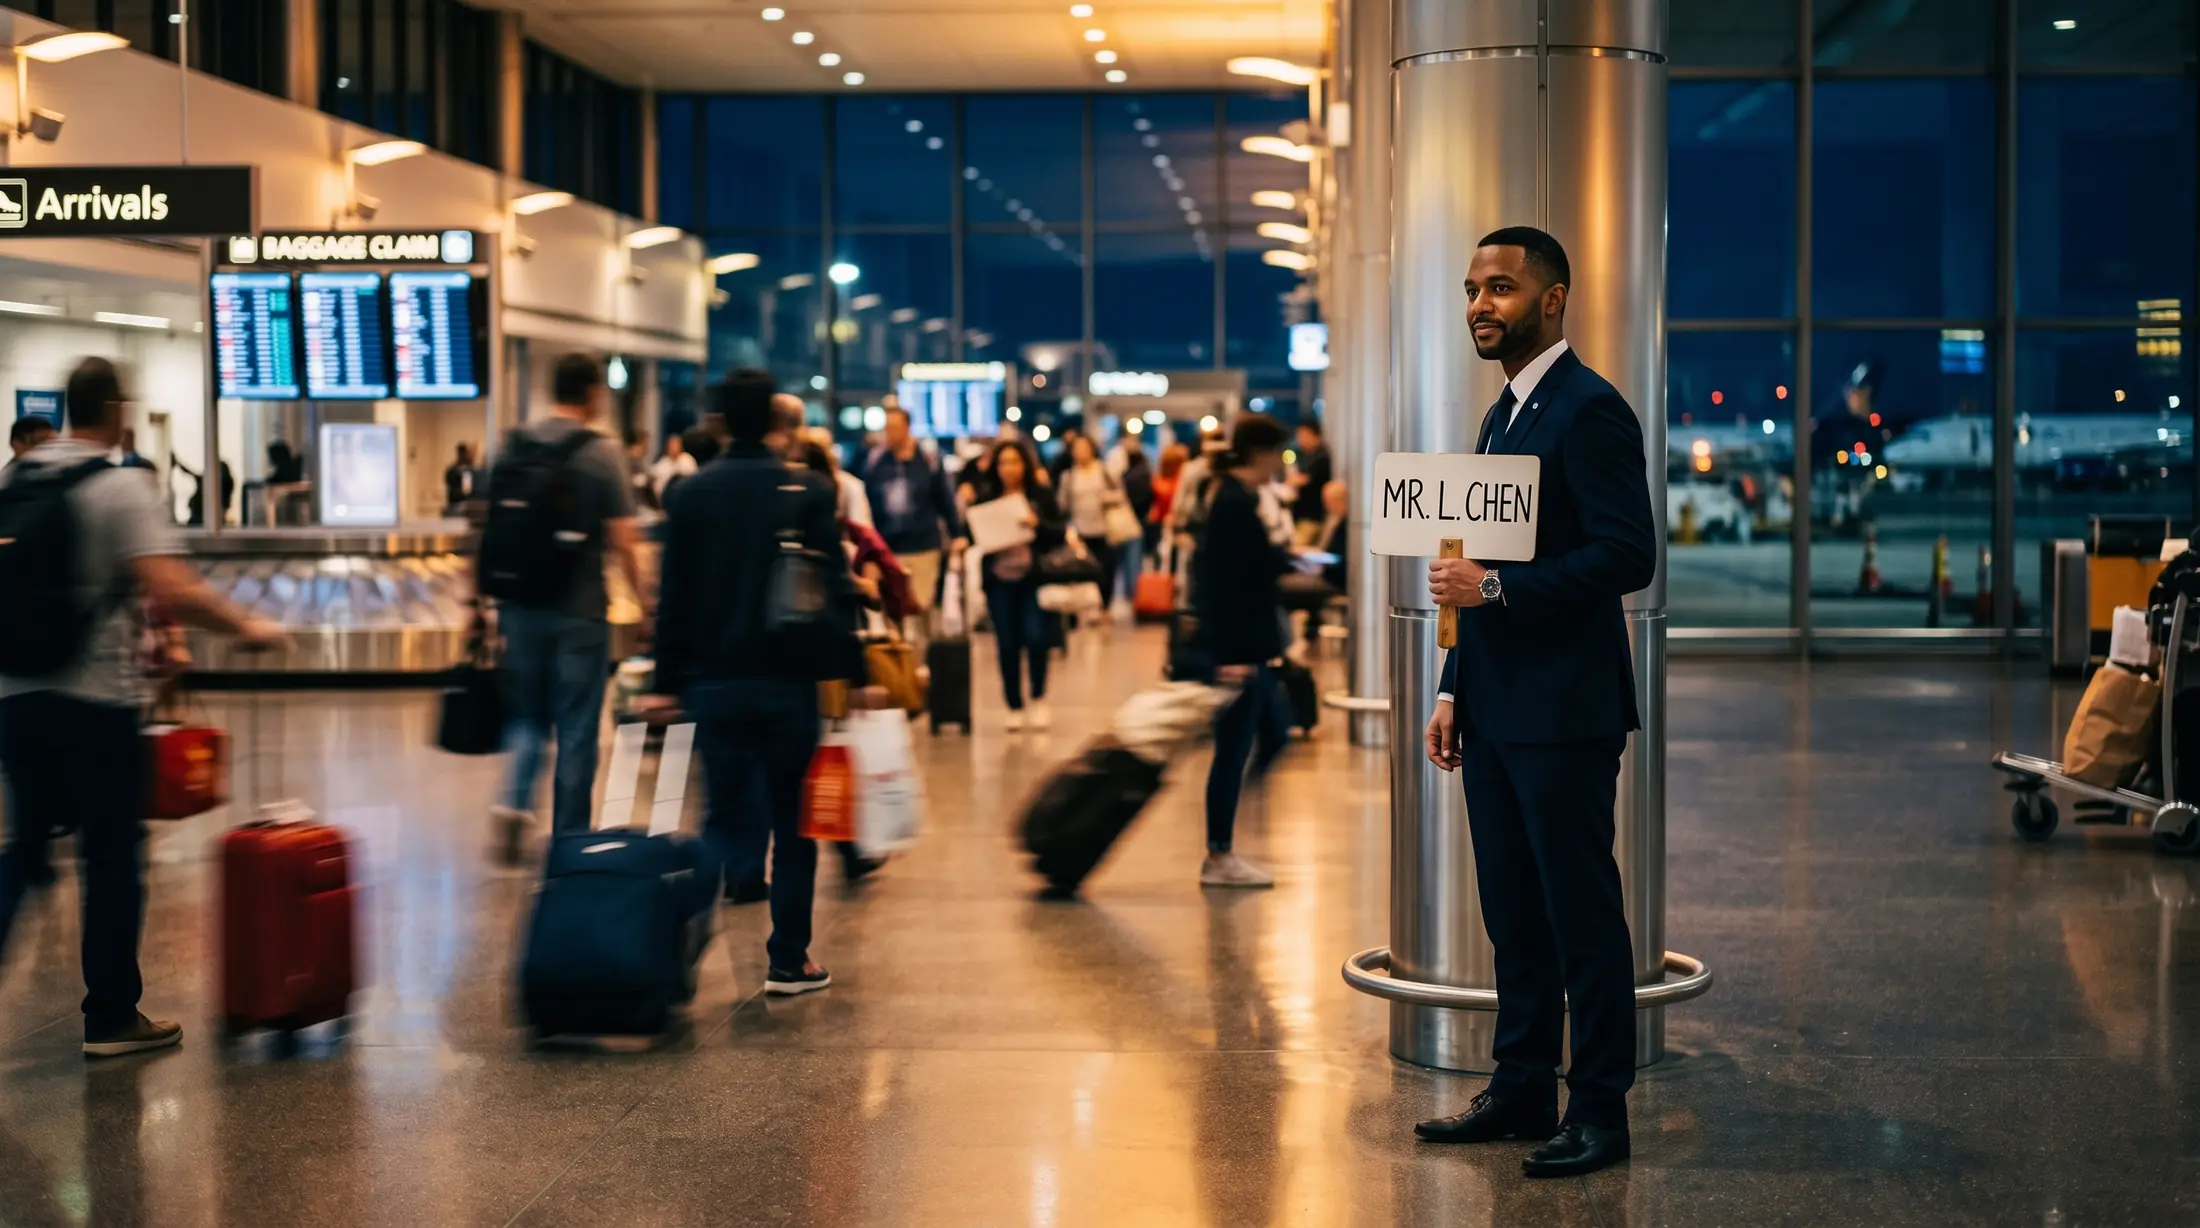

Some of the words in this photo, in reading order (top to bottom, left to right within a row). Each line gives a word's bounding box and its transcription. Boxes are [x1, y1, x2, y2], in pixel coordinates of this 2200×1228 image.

[34, 184, 169, 221] Arrivals
[262, 235, 368, 261] BAGGAGE
[369, 234, 439, 260] CLAIM
[1383, 478, 1430, 519] MR.
[1438, 480, 1461, 521] L.
[1465, 481, 1532, 523] CHEN
